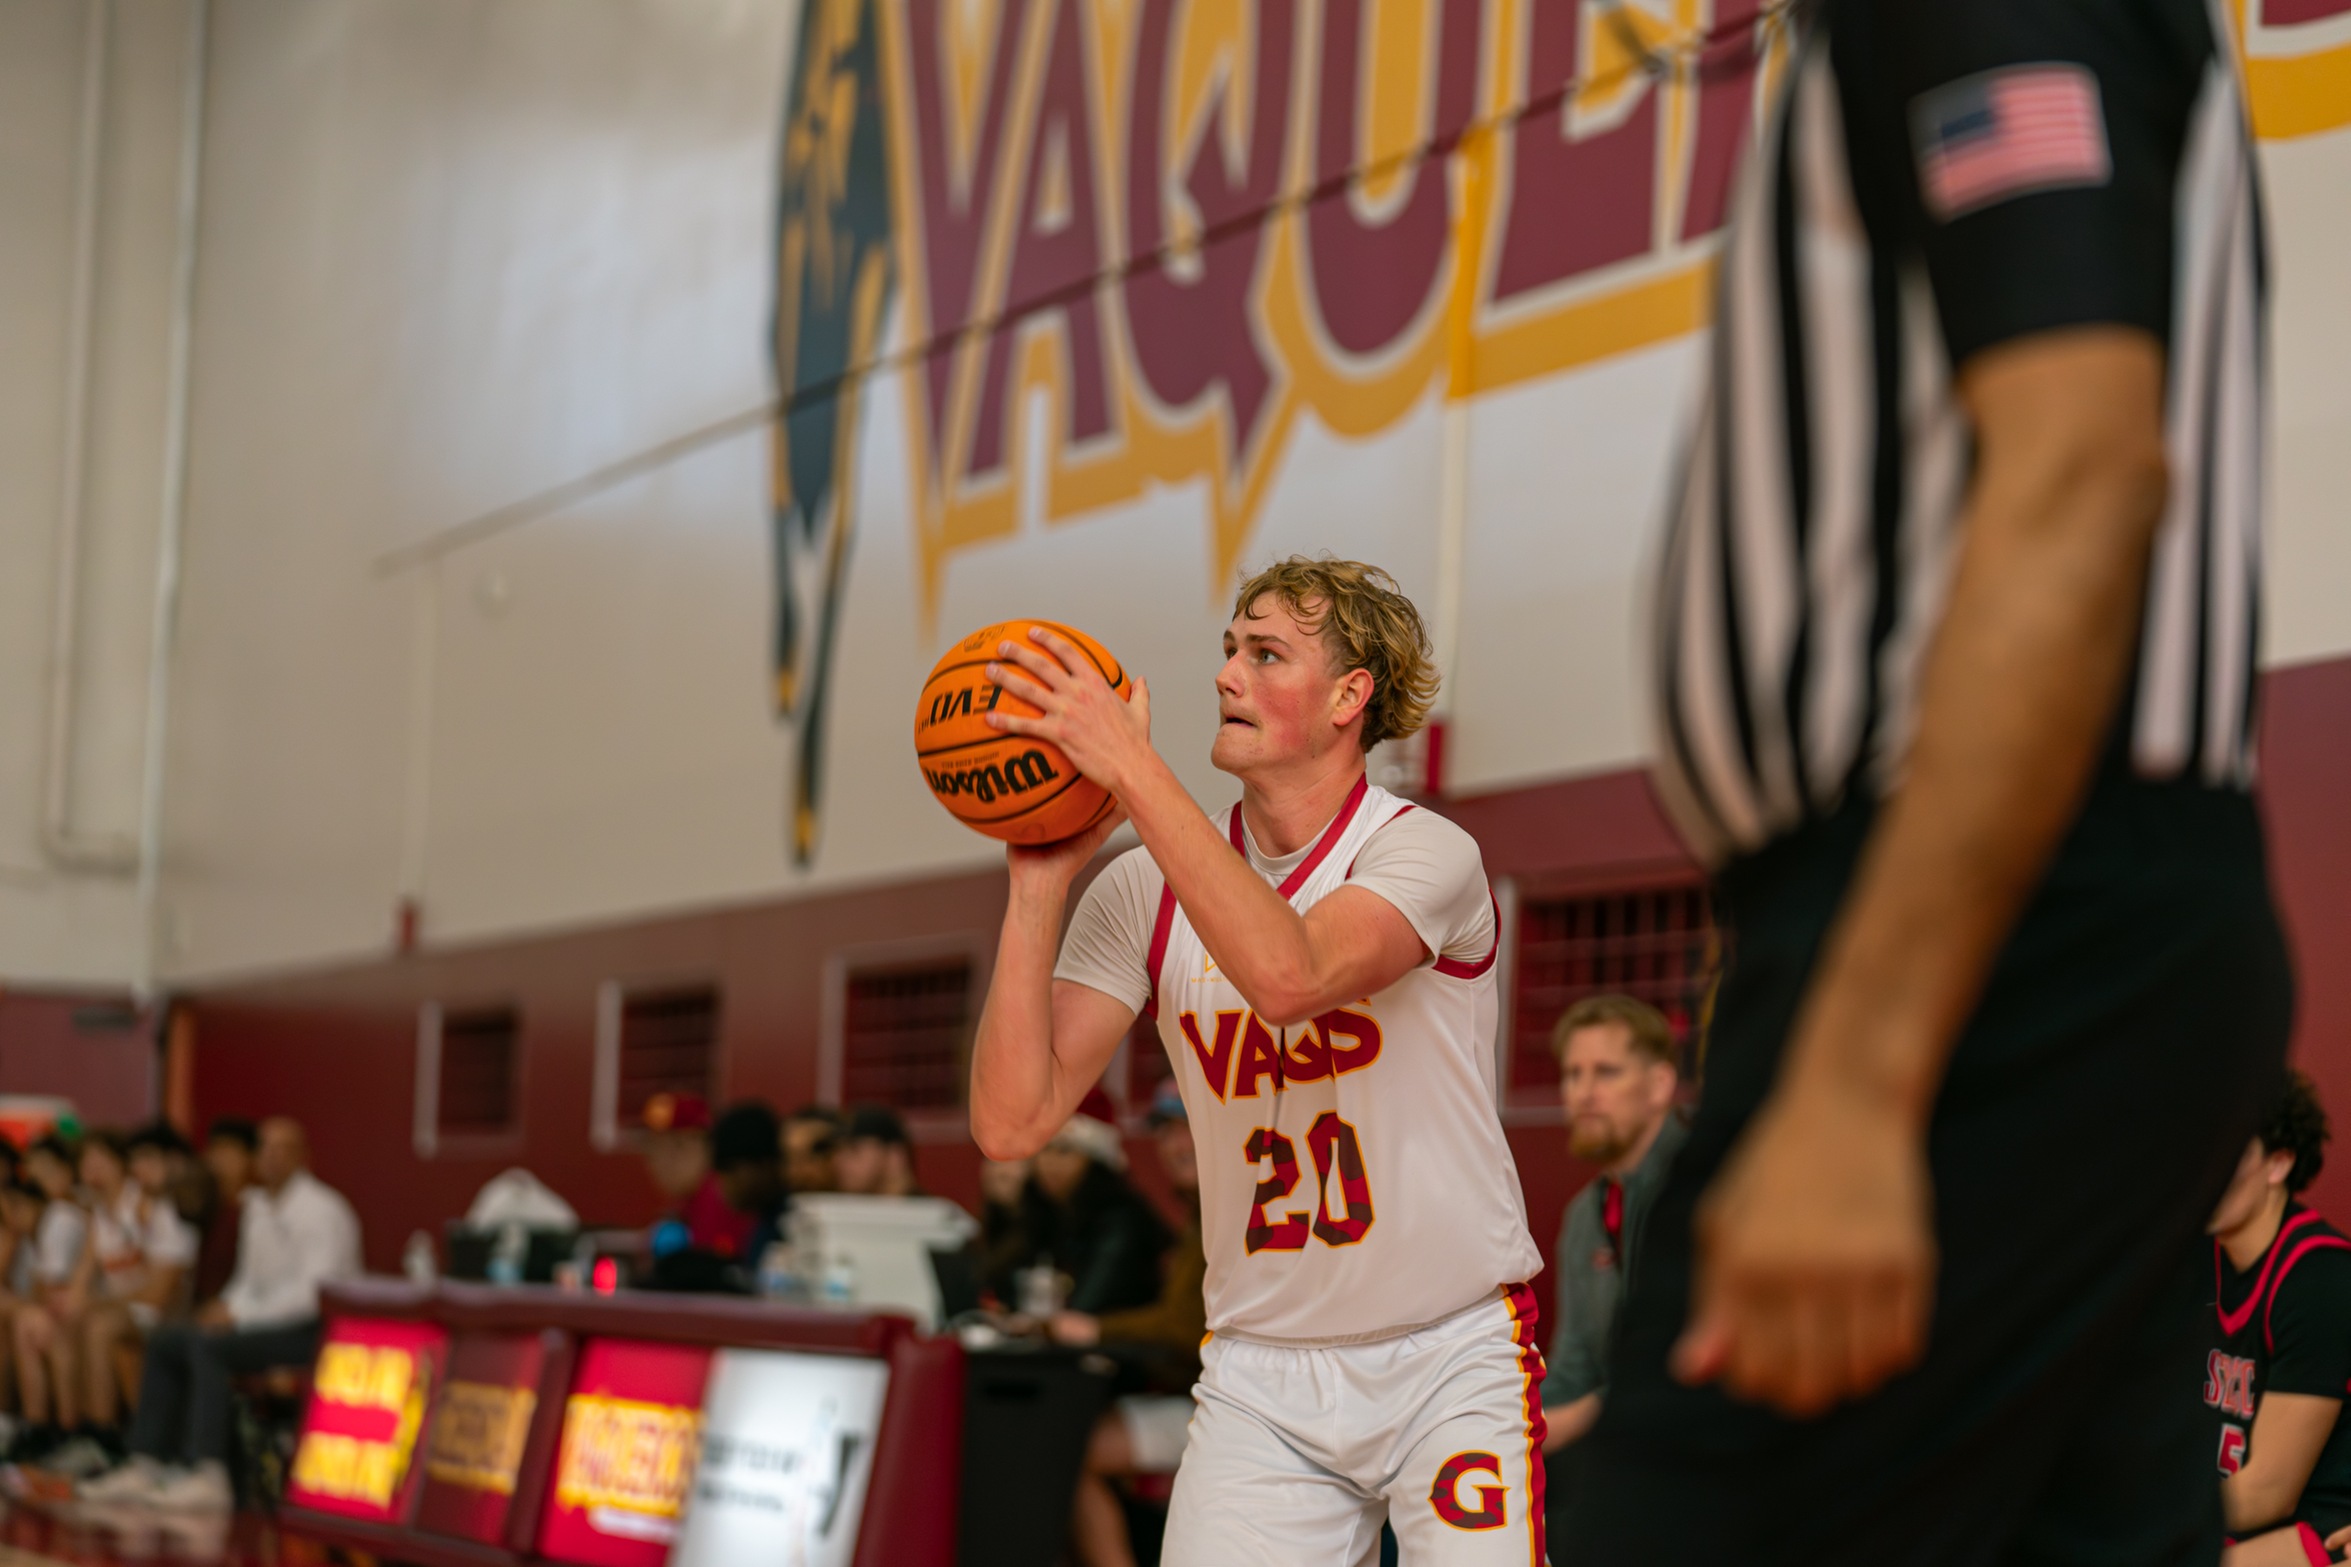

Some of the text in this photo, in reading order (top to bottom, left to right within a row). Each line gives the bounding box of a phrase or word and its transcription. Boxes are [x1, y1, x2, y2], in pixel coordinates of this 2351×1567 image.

[923, 750, 1059, 805] Wilson
[1178, 996, 1384, 1106] VAQS
[1242, 1109, 1376, 1257] 20
[1426, 1448, 1512, 1533] G
